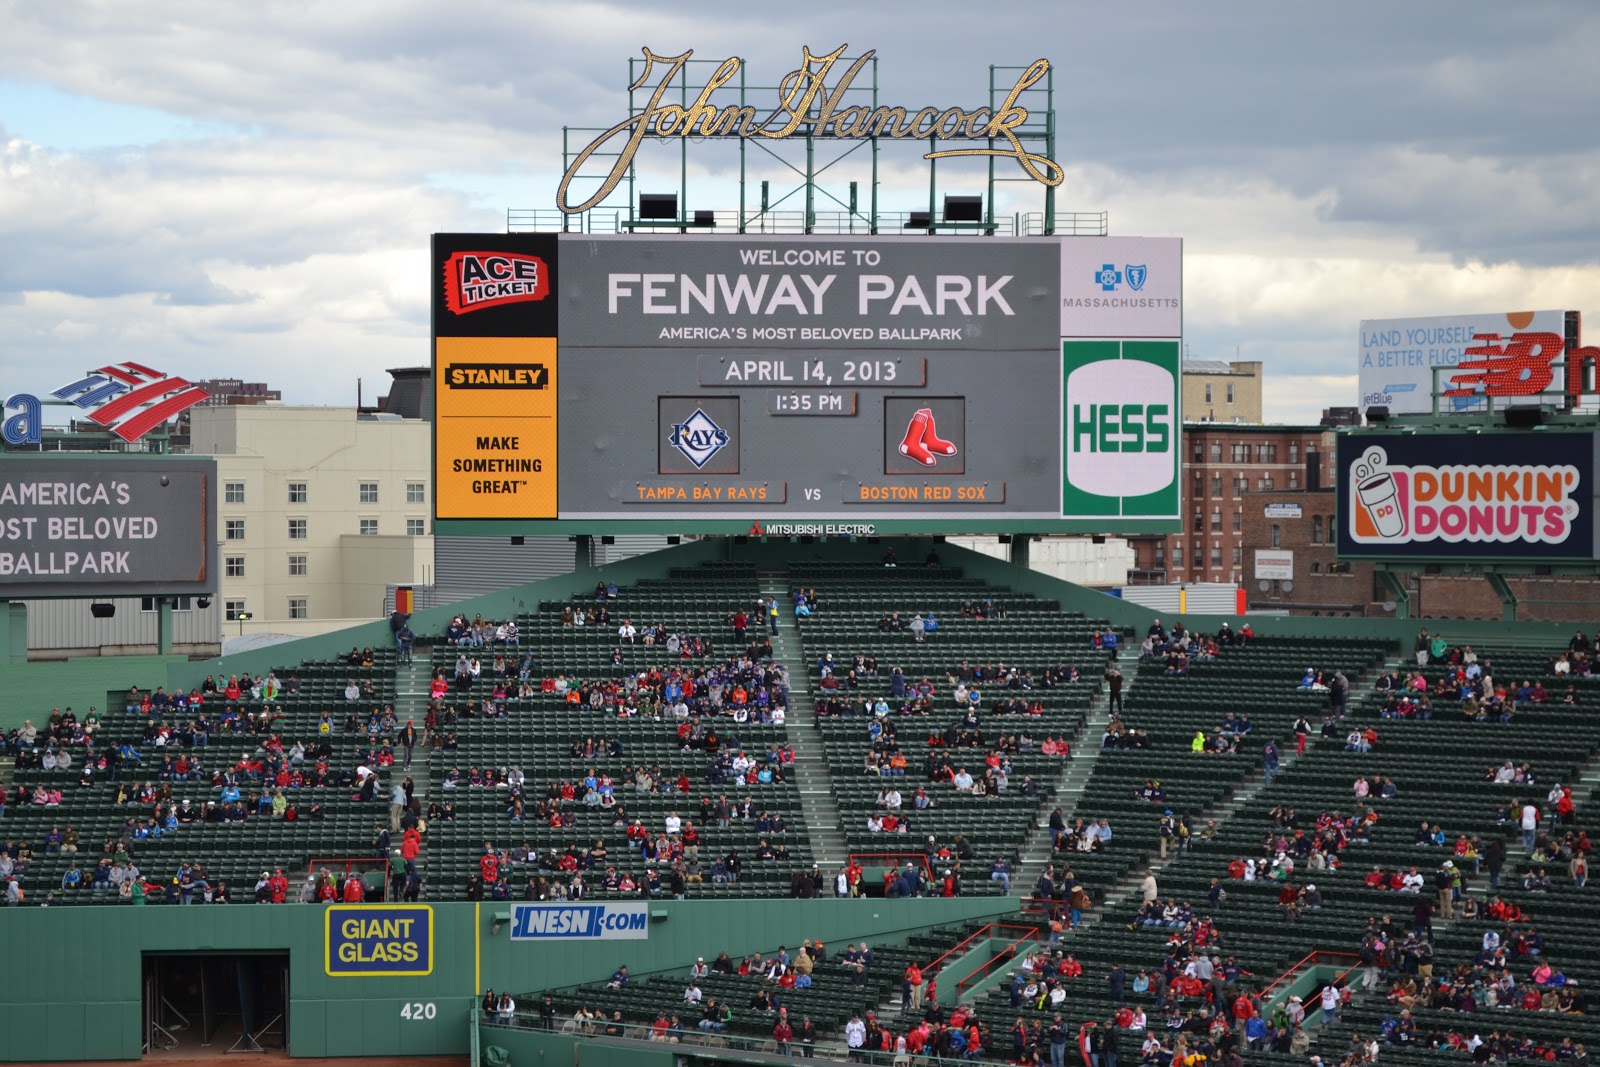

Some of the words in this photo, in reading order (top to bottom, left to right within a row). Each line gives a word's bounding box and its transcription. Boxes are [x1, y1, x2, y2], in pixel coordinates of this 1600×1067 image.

[557, 46, 757, 214] John
[753, 44, 1064, 187] Hancock
[740, 250, 845, 265] WELCOME
[853, 250, 880, 265] TO
[463, 255, 538, 283] ACE
[464, 281, 537, 302] TICKET
[609, 274, 836, 314] FENWAY
[859, 275, 1015, 315] PARK
[1063, 298, 1179, 308] MASSACHUSETTS
[659, 328, 747, 339] AMERICA'S
[753, 328, 796, 339] MOST
[801, 328, 873, 339] BELOVED
[879, 328, 961, 339] BALLPARK
[1363, 331, 1401, 348] LAND
[1407, 326, 1475, 345] YOURSELF
[1363, 353, 1373, 368] A
[1378, 350, 1423, 368] BETTER
[452, 368, 541, 384] STANLEY
[725, 361, 793, 380] APRIL
[804, 361, 832, 384] 14,
[844, 361, 896, 380] 2013
[777, 394, 811, 410] 1:35
[819, 394, 841, 410] PM
[1363, 392, 1392, 407] jetBlue
[1, 393, 42, 443] a
[1074, 404, 1169, 452] HESS
[477, 437, 519, 449] MAKE
[671, 424, 729, 452] RAYS
[453, 459, 541, 472] SOMETHING
[0, 481, 131, 505] AMERICA'S
[637, 486, 686, 499] TAMPA
[694, 485, 721, 499] BAY
[728, 485, 767, 499] RAYS
[805, 489, 821, 500] VS
[860, 486, 918, 499] BOSTON
[924, 485, 951, 499] RED
[958, 486, 985, 499] SOX
[1414, 471, 1573, 503] DUNKIN'
[48, 517, 157, 539] BELOVED
[767, 524, 823, 534] MITSUBISHI
[826, 525, 875, 534] ELECTRIC
[0, 552, 130, 574] BALLPARK
[342, 919, 414, 939] GIANT
[339, 942, 418, 962] GLASS
[401, 1003, 436, 1019] 420
